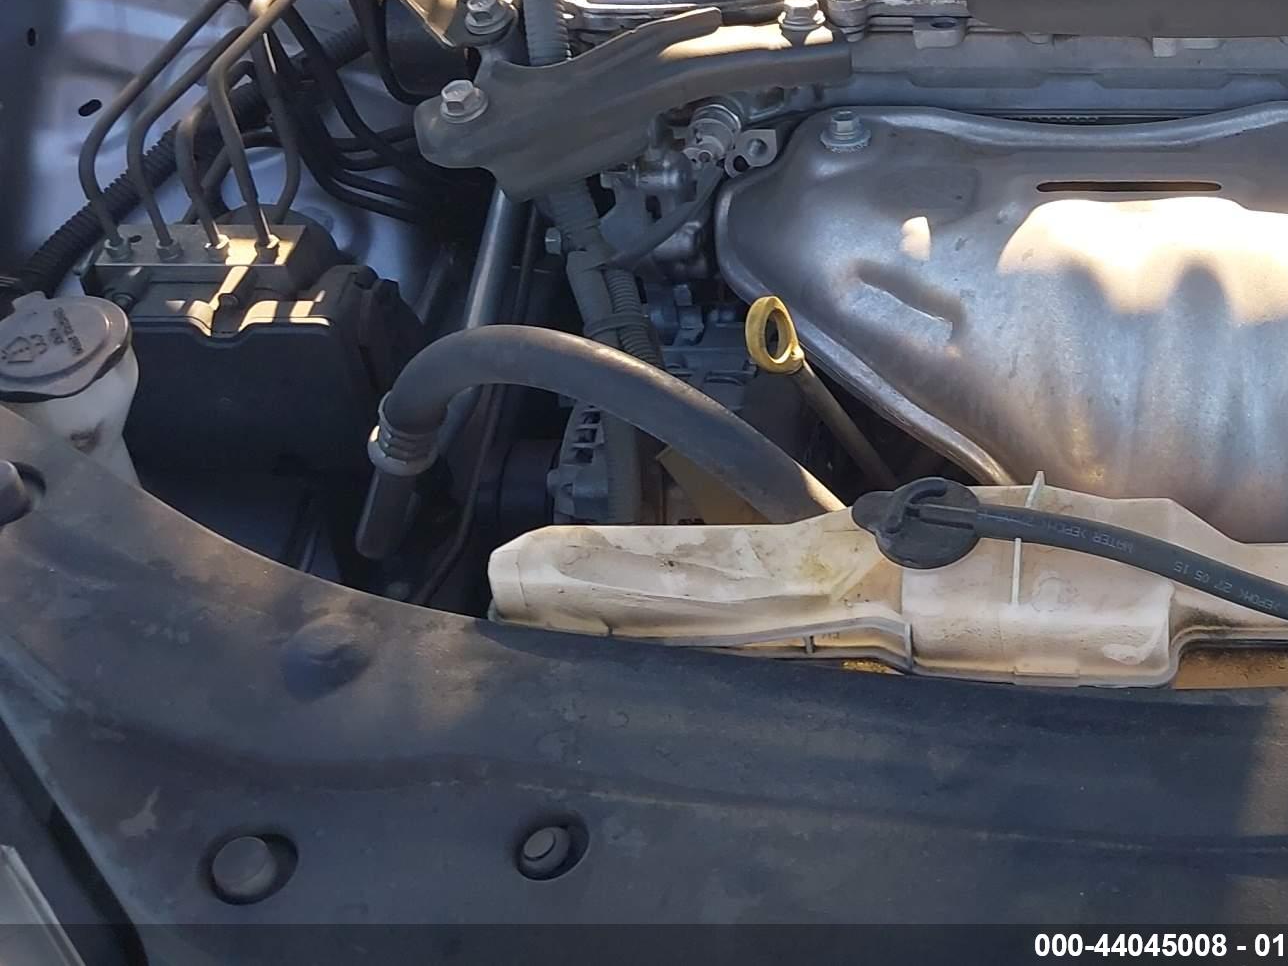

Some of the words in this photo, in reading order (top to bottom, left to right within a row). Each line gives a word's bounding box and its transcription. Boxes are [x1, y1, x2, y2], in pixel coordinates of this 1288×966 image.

[1173, 560, 1190, 576] 15
[1193, 568, 1211, 585] 05
[1213, 577, 1233, 594] 27
